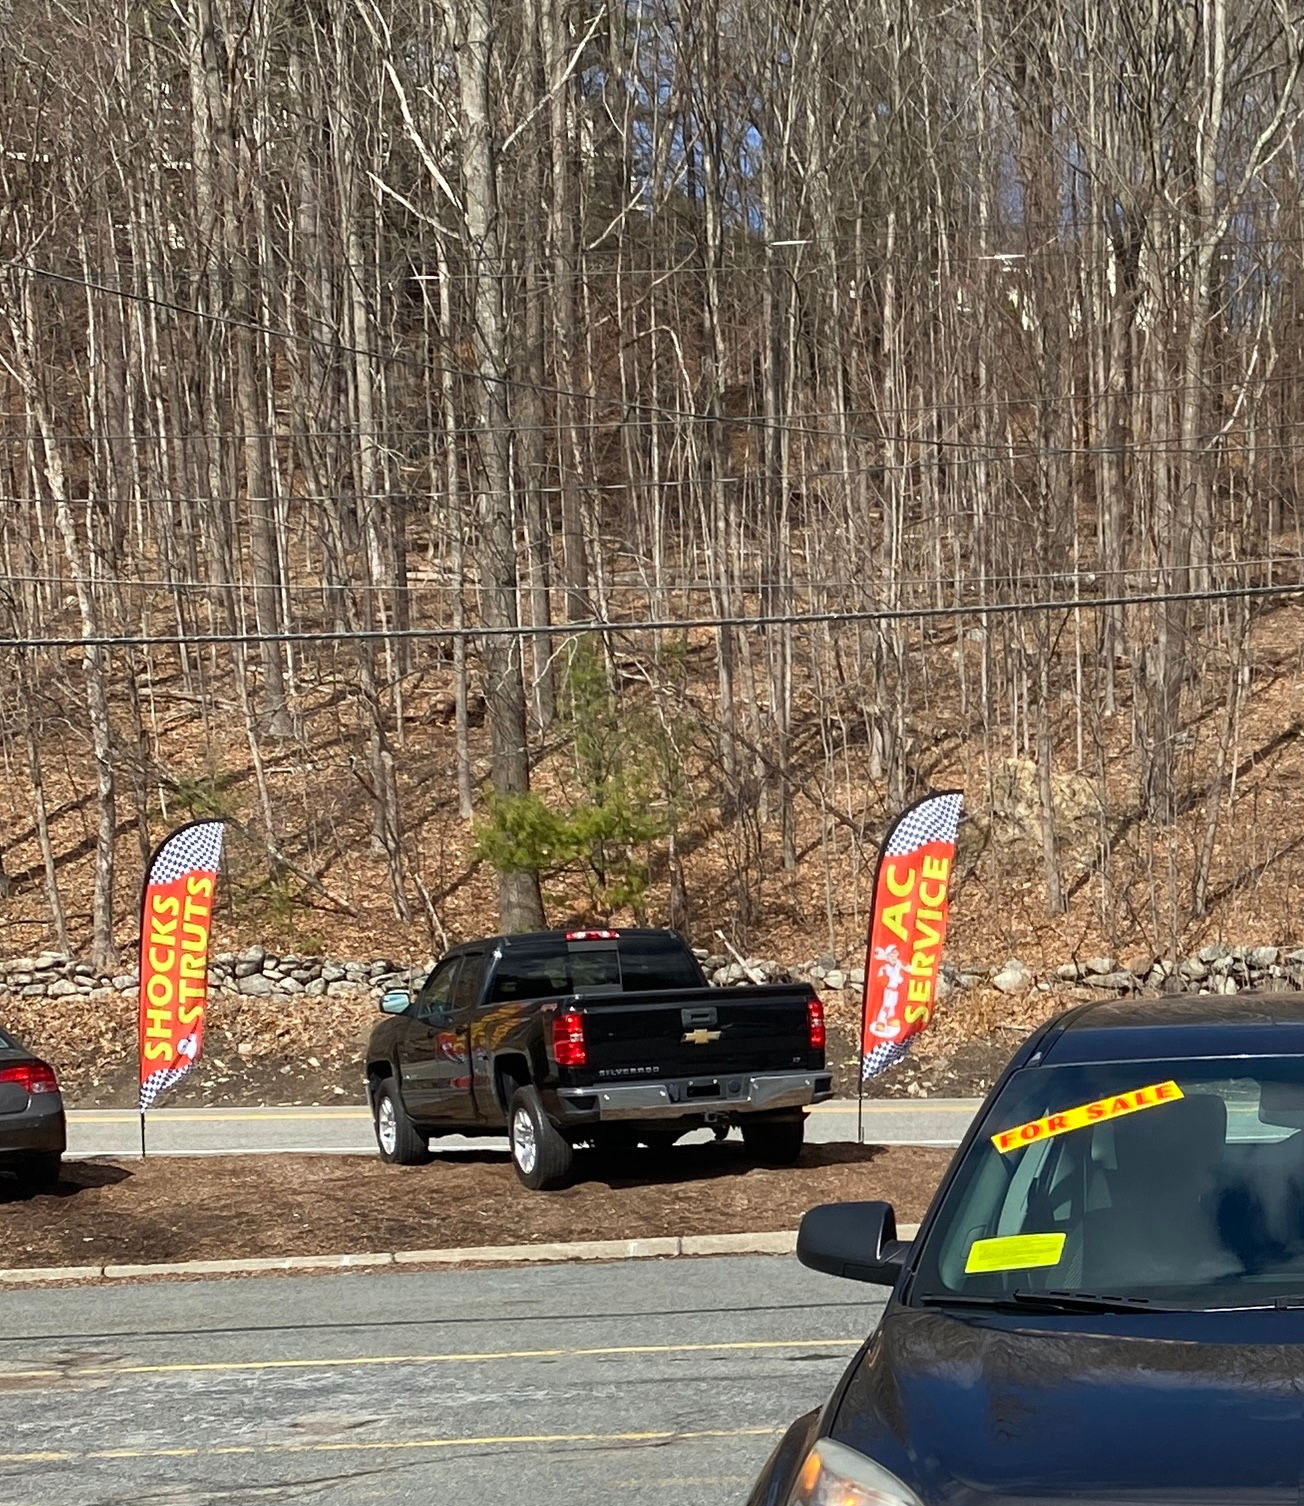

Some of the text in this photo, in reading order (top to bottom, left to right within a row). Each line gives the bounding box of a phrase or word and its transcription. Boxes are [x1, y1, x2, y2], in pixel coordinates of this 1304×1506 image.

[178, 876, 213, 1025] STRUTS
[881, 864, 917, 943] AC
[904, 855, 950, 1026] SERVICE
[144, 894, 179, 1062] SHOCKS
[598, 1066, 660, 1077] SILVERADO
[1000, 1084, 1176, 1149] FOR SALE
